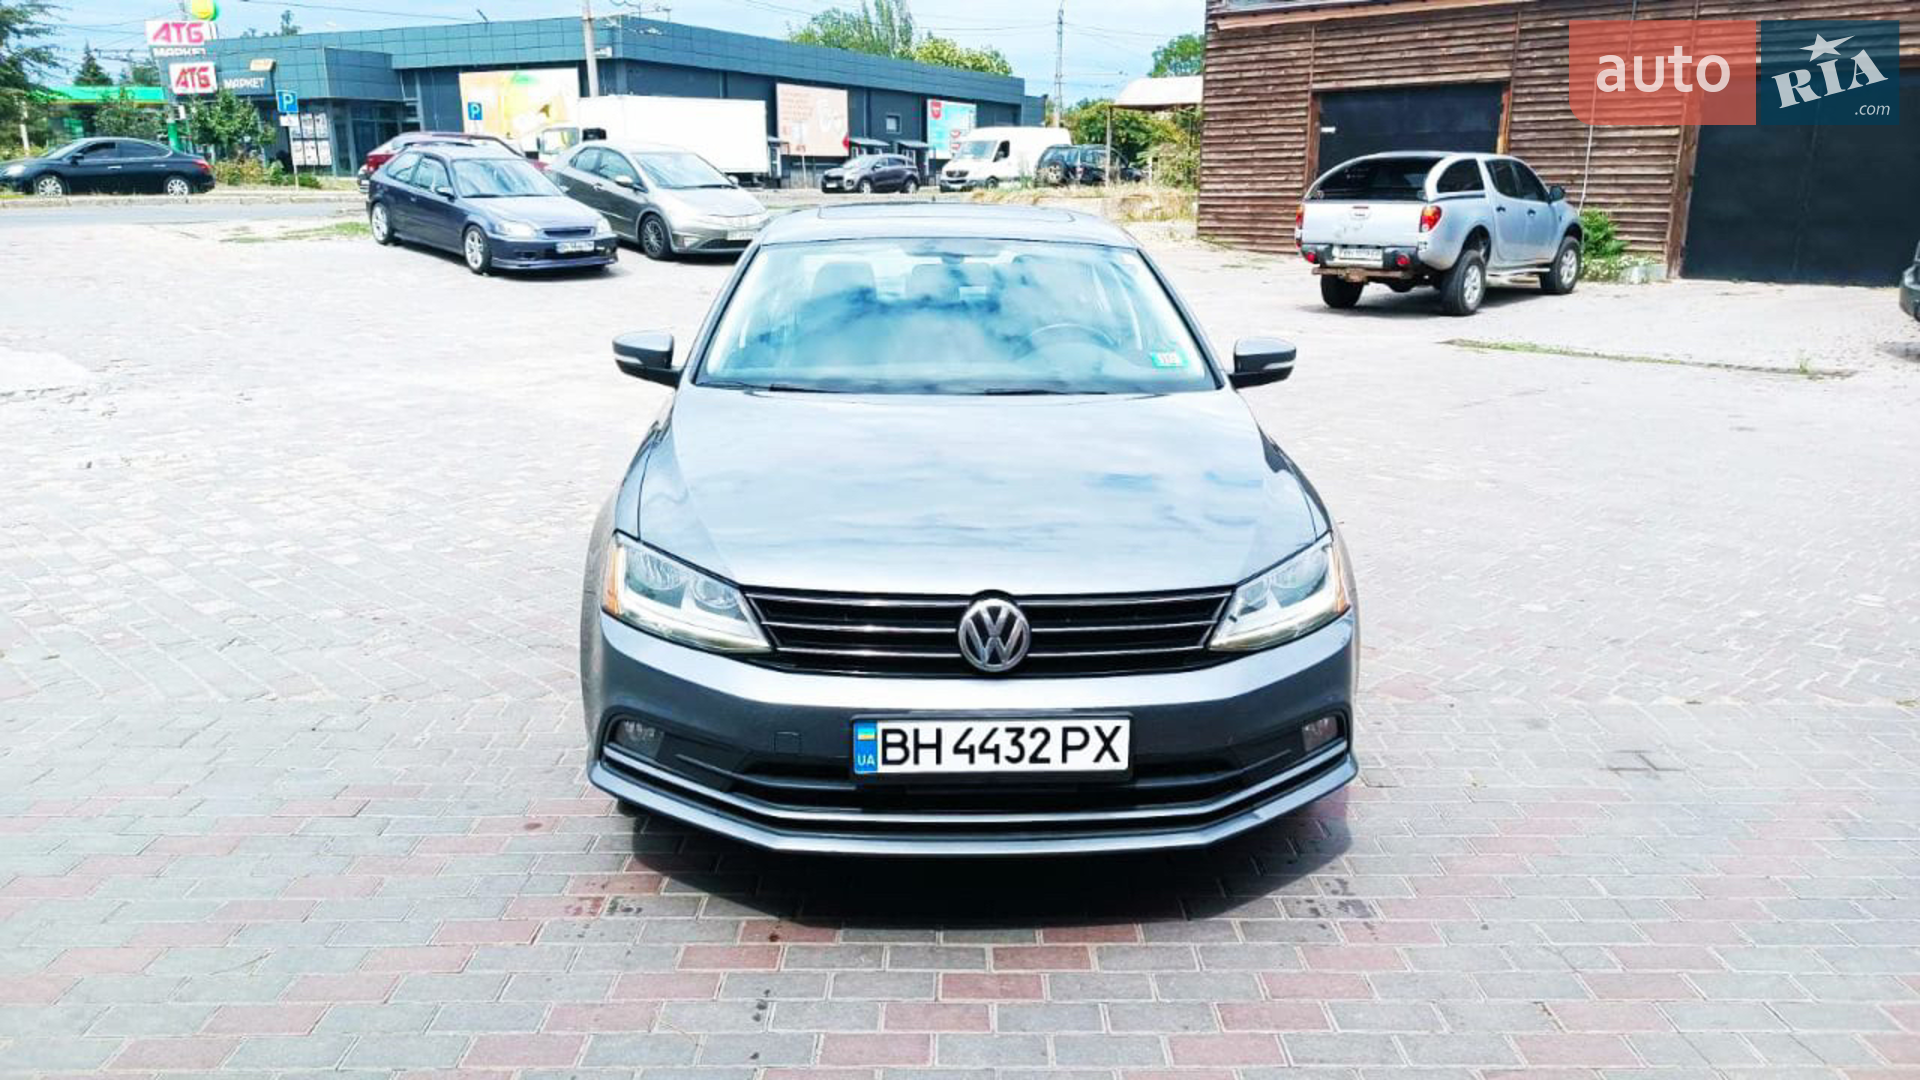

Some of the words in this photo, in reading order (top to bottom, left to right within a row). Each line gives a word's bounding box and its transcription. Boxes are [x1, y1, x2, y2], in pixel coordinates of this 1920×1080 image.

[282, 93, 294, 111] P
[470, 104, 479, 119] P
[881, 728, 942, 765] BH
[953, 727, 1051, 764] 4432
[1062, 725, 1122, 763] PX
[857, 755, 875, 766] UA
